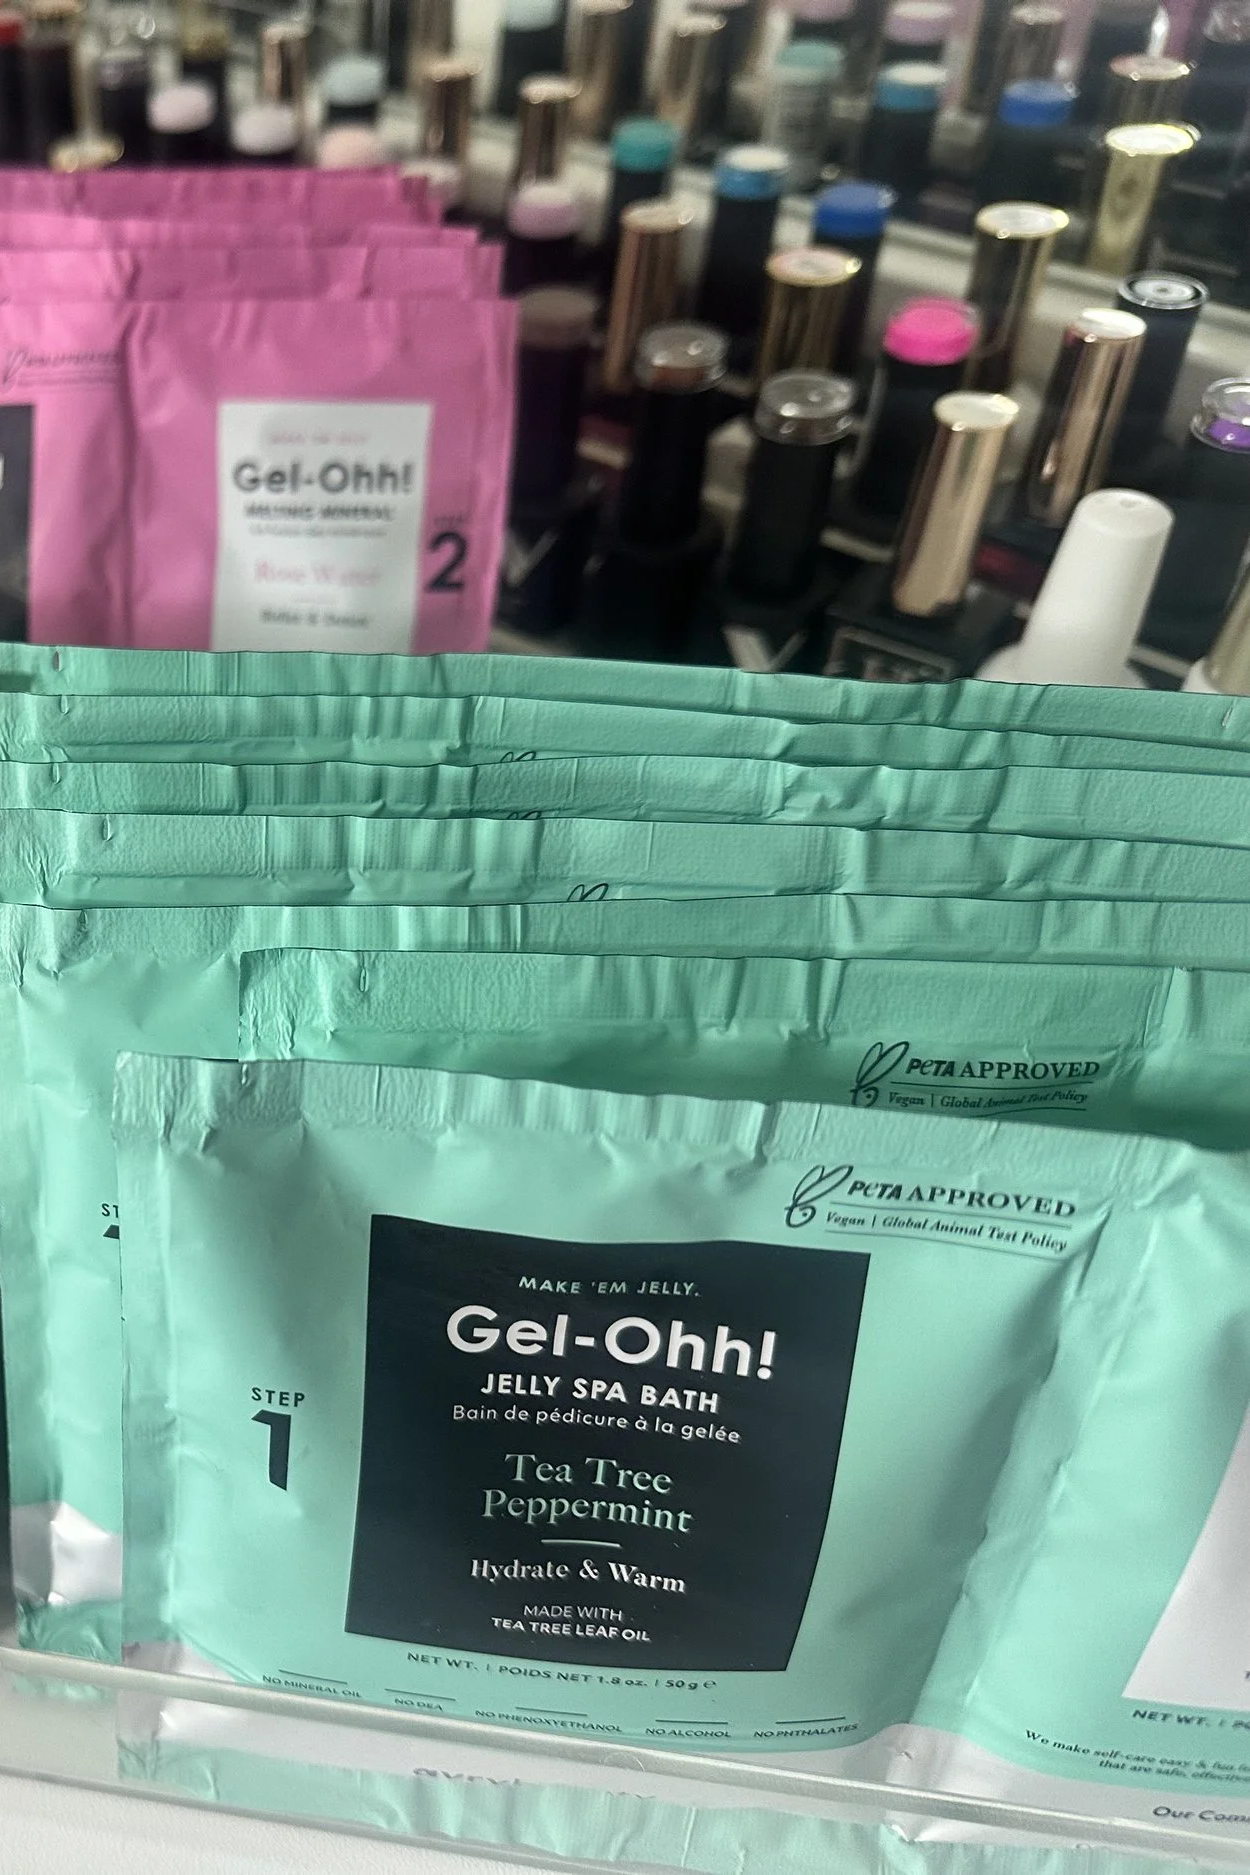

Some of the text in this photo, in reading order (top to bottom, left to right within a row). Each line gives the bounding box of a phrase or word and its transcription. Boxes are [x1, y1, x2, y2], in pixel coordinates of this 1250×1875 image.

[233, 460, 413, 494] Gel-Ohh!
[425, 531, 467, 592] 2
[961, 1061, 1100, 1080] APPROVED
[888, 1090, 1088, 1108] Vegan Global Policy
[101, 1203, 120, 1219] ST
[909, 1185, 1076, 1218] APPROVED
[826, 1211, 1068, 1252] Vegan Global Animal Test Policy
[518, 1276, 701, 1297] MAKE 'EM JELLY.
[447, 1305, 776, 1380] Gel-Ohh!
[251, 1386, 305, 1407] STEP
[481, 1373, 719, 1414] JELLY SPA BATH
[453, 1405, 741, 1444] Bain de pédicure à la gelée
[251, 1409, 292, 1491] 1
[505, 1453, 672, 1494] Tea Tree
[482, 1489, 694, 1533] Peppermint
[471, 1559, 687, 1594] Hydrate & Warm
[523, 1604, 622, 1622] MADE WITH
[491, 1617, 651, 1642] TEA TREE LEAF OIL
[407, 1652, 698, 1690] NET WT. POIDS NET 1.8 oz. 50 g
[262, 1675, 362, 1698] NO MINERAL OIL
[394, 1698, 443, 1712] NO DEA
[1132, 1709, 1171, 1721] NET
[475, 1710, 622, 1733] NO PHENOXYETHANOL
[645, 1727, 731, 1739] NO ALCOHOL
[754, 1723, 859, 1738] NO PHTHALATES
[1025, 1729, 1090, 1754] We make
[1099, 1759, 1152, 1773] that are
[1153, 1806, 1194, 1819] Our
